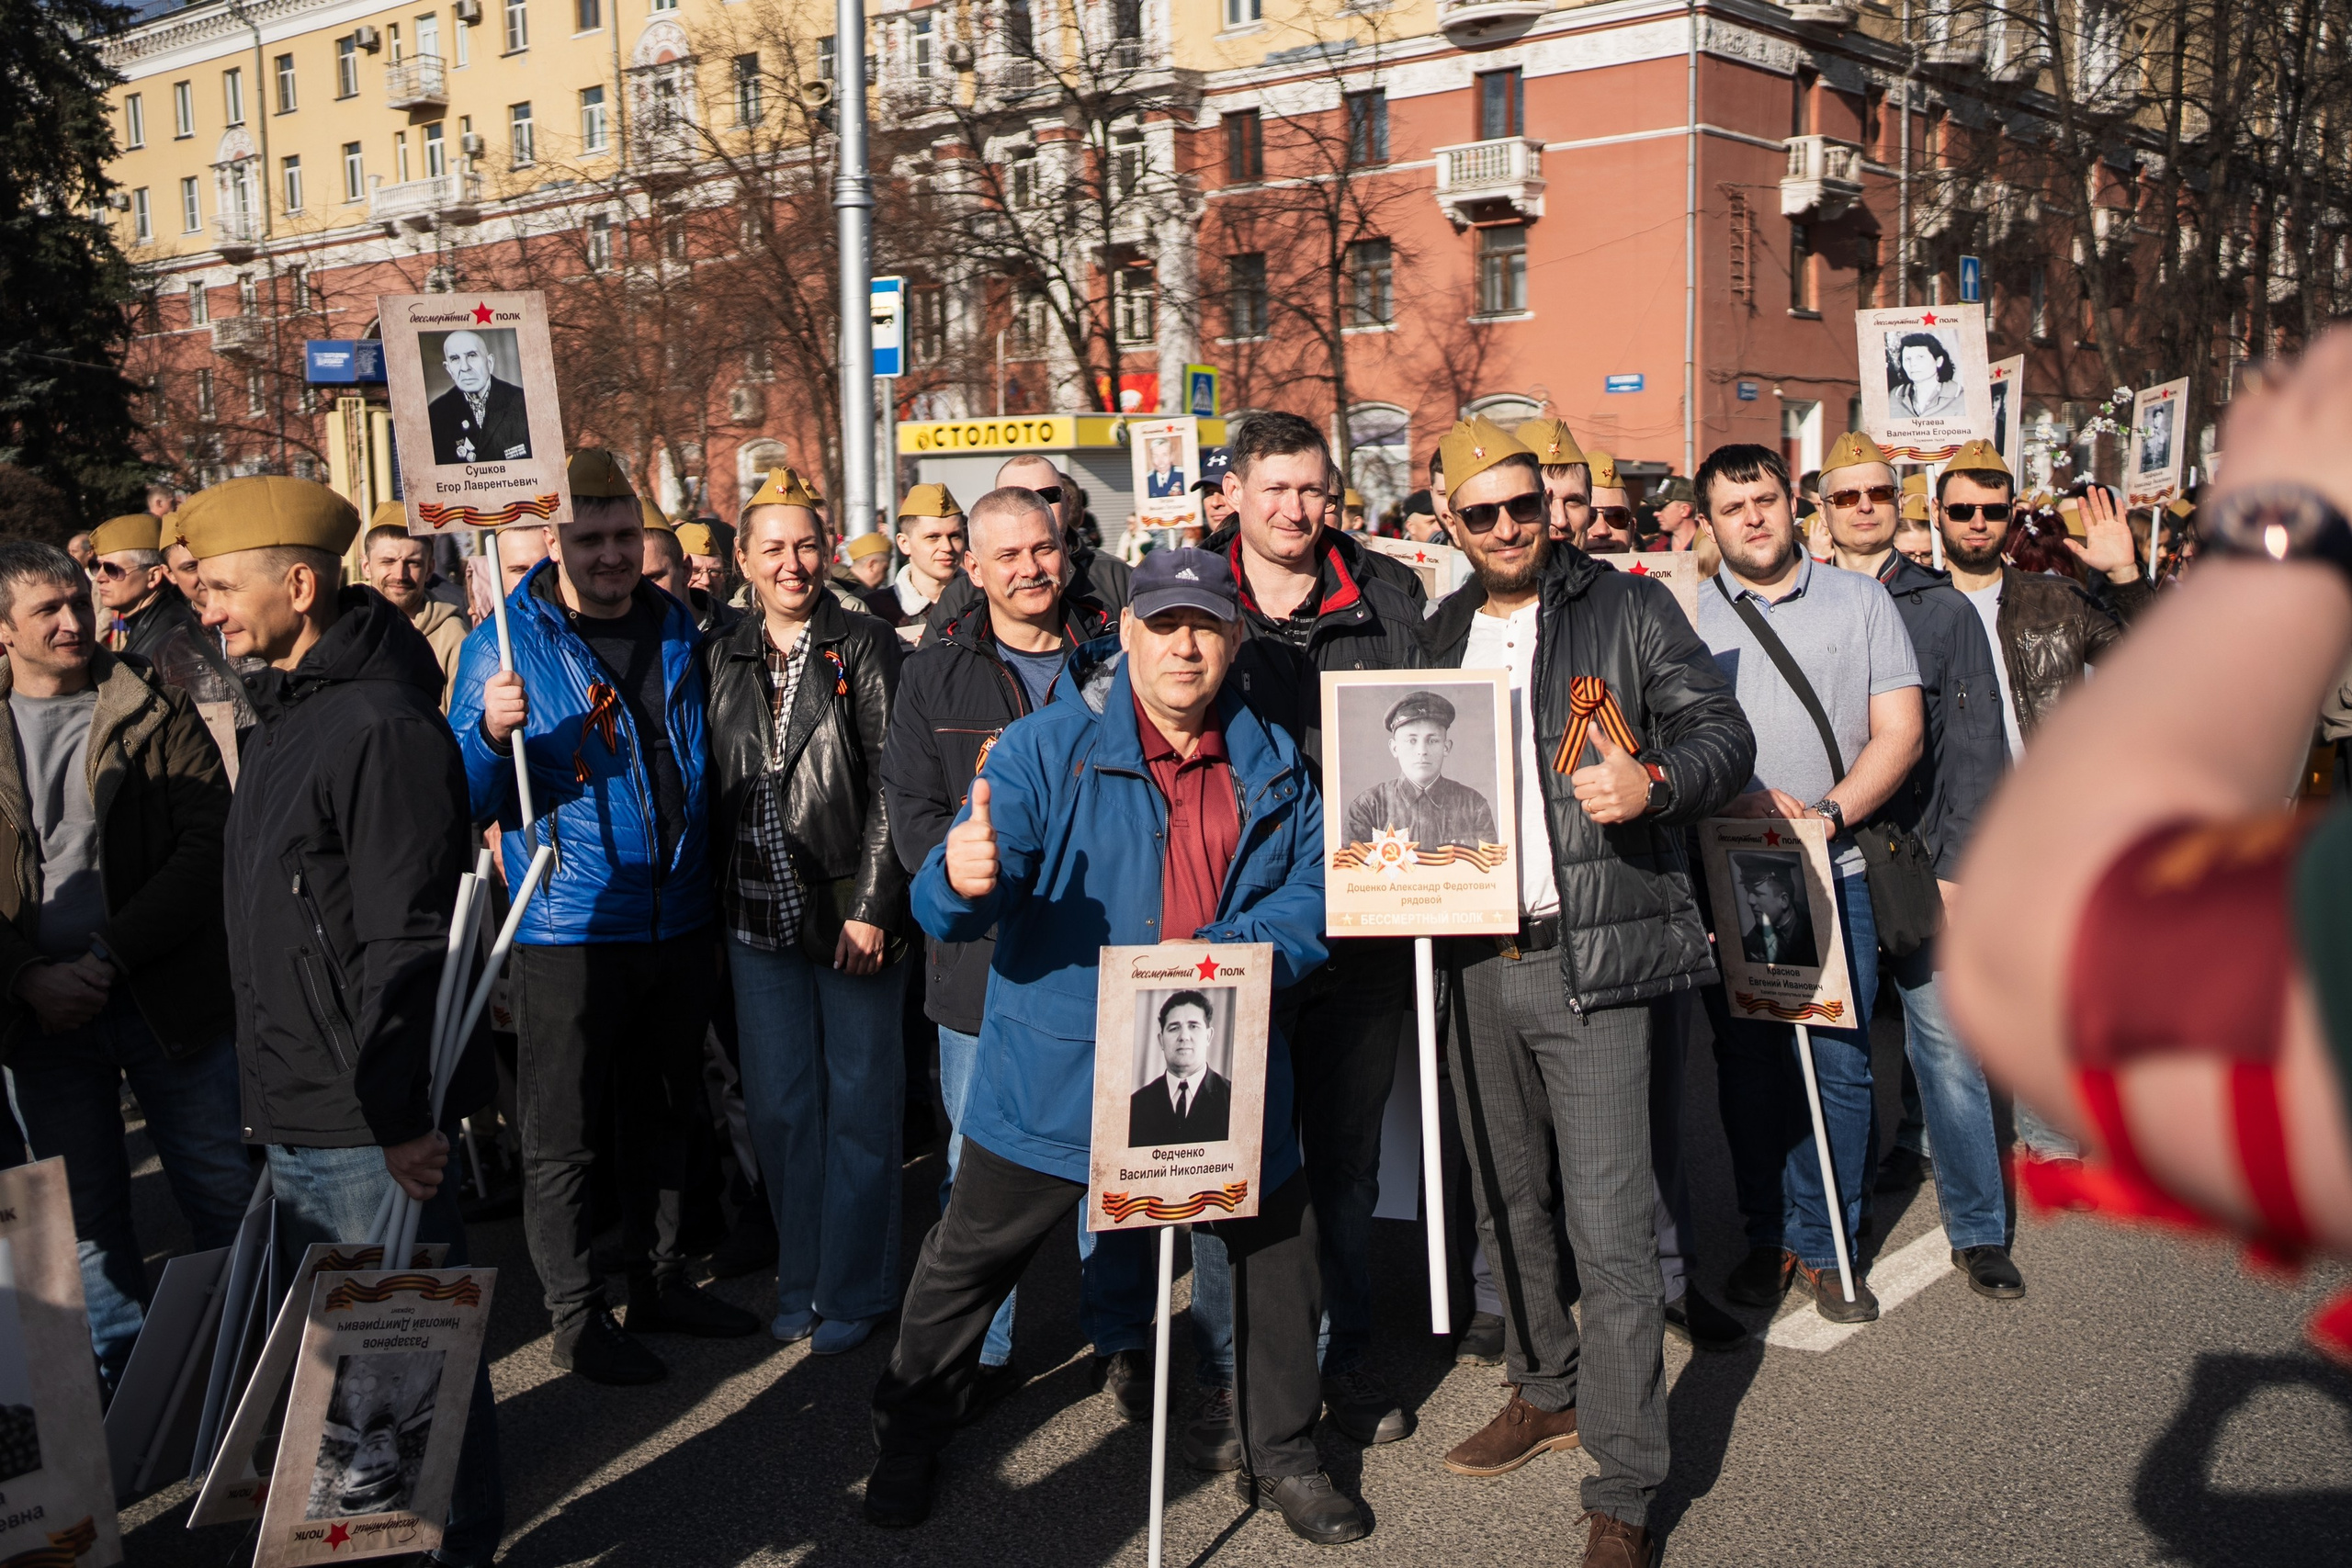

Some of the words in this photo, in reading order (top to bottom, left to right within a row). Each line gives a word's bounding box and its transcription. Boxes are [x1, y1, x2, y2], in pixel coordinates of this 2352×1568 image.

[408, 302, 470, 324] бессмертный
[1912, 419, 1945, 427] Чугаева
[933, 422, 1054, 446] СТОЛОТО
[1933, 428, 1972, 436] Егоровна
[466, 465, 506, 478] Сушков
[435, 482, 460, 493] Егор
[464, 477, 538, 491] Лаврентьевич
[1347, 883, 1387, 894] Доценко
[1389, 882, 1441, 893] Александр
[1443, 881, 1497, 891] Федотович
[1401, 895, 1442, 907] рядовой
[1361, 910, 1451, 926] БЕССМЕРТНЫЙ
[1453, 912, 1484, 924] ПОЛК
[1131, 955, 1195, 981] бессмертный
[1767, 965, 1801, 976] Краснов
[1748, 976, 1781, 987] Евгений
[1782, 980, 1824, 991] Иванович
[1152, 1148, 1205, 1161] Федченко
[1120, 1166, 1167, 1180] Василий
[1170, 1163, 1234, 1176] Николаевич
[337, 1317, 412, 1331] Дмитриевич
[413, 1317, 460, 1331] Николай
[363, 1335, 430, 1350] Раззарёнов
[351, 1517, 420, 1542] бессмертный
